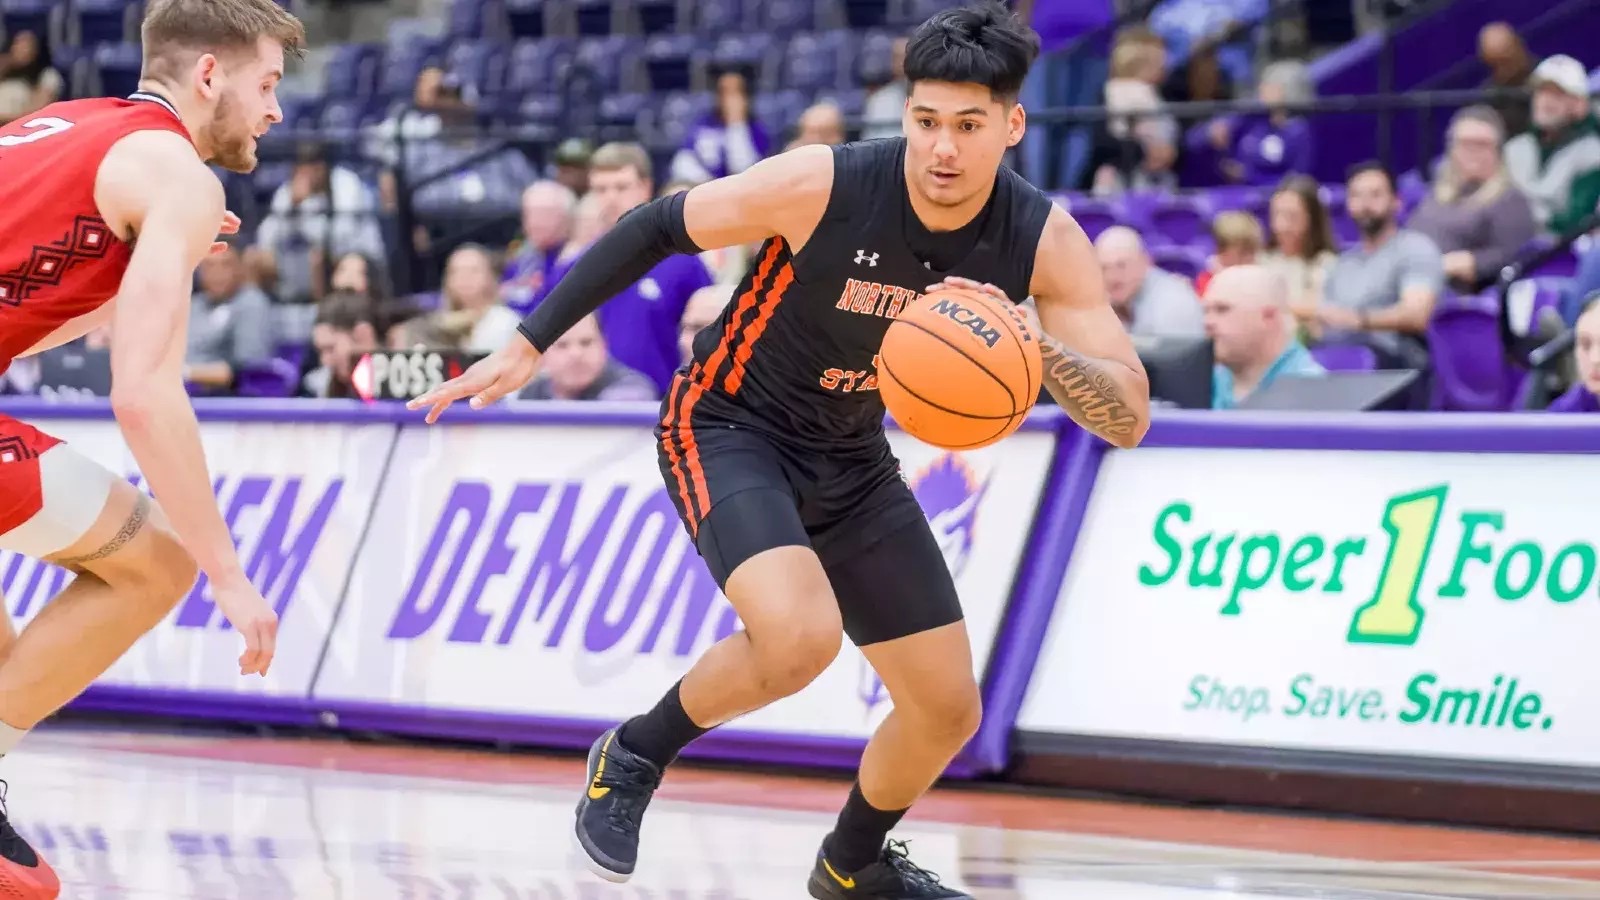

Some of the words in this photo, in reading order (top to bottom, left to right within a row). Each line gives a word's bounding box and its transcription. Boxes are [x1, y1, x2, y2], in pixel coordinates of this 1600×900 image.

[928, 298, 1002, 349] NCAA
[371, 352, 444, 398] POSS
[388, 481, 742, 657] DEMON
[1138, 501, 1367, 616] Super
[1346, 482, 1450, 646] 1
[1437, 510, 1600, 603] Foo
[1183, 674, 1271, 722] Shop.
[1282, 672, 1388, 721] Save.
[1397, 672, 1553, 731] Smile.
